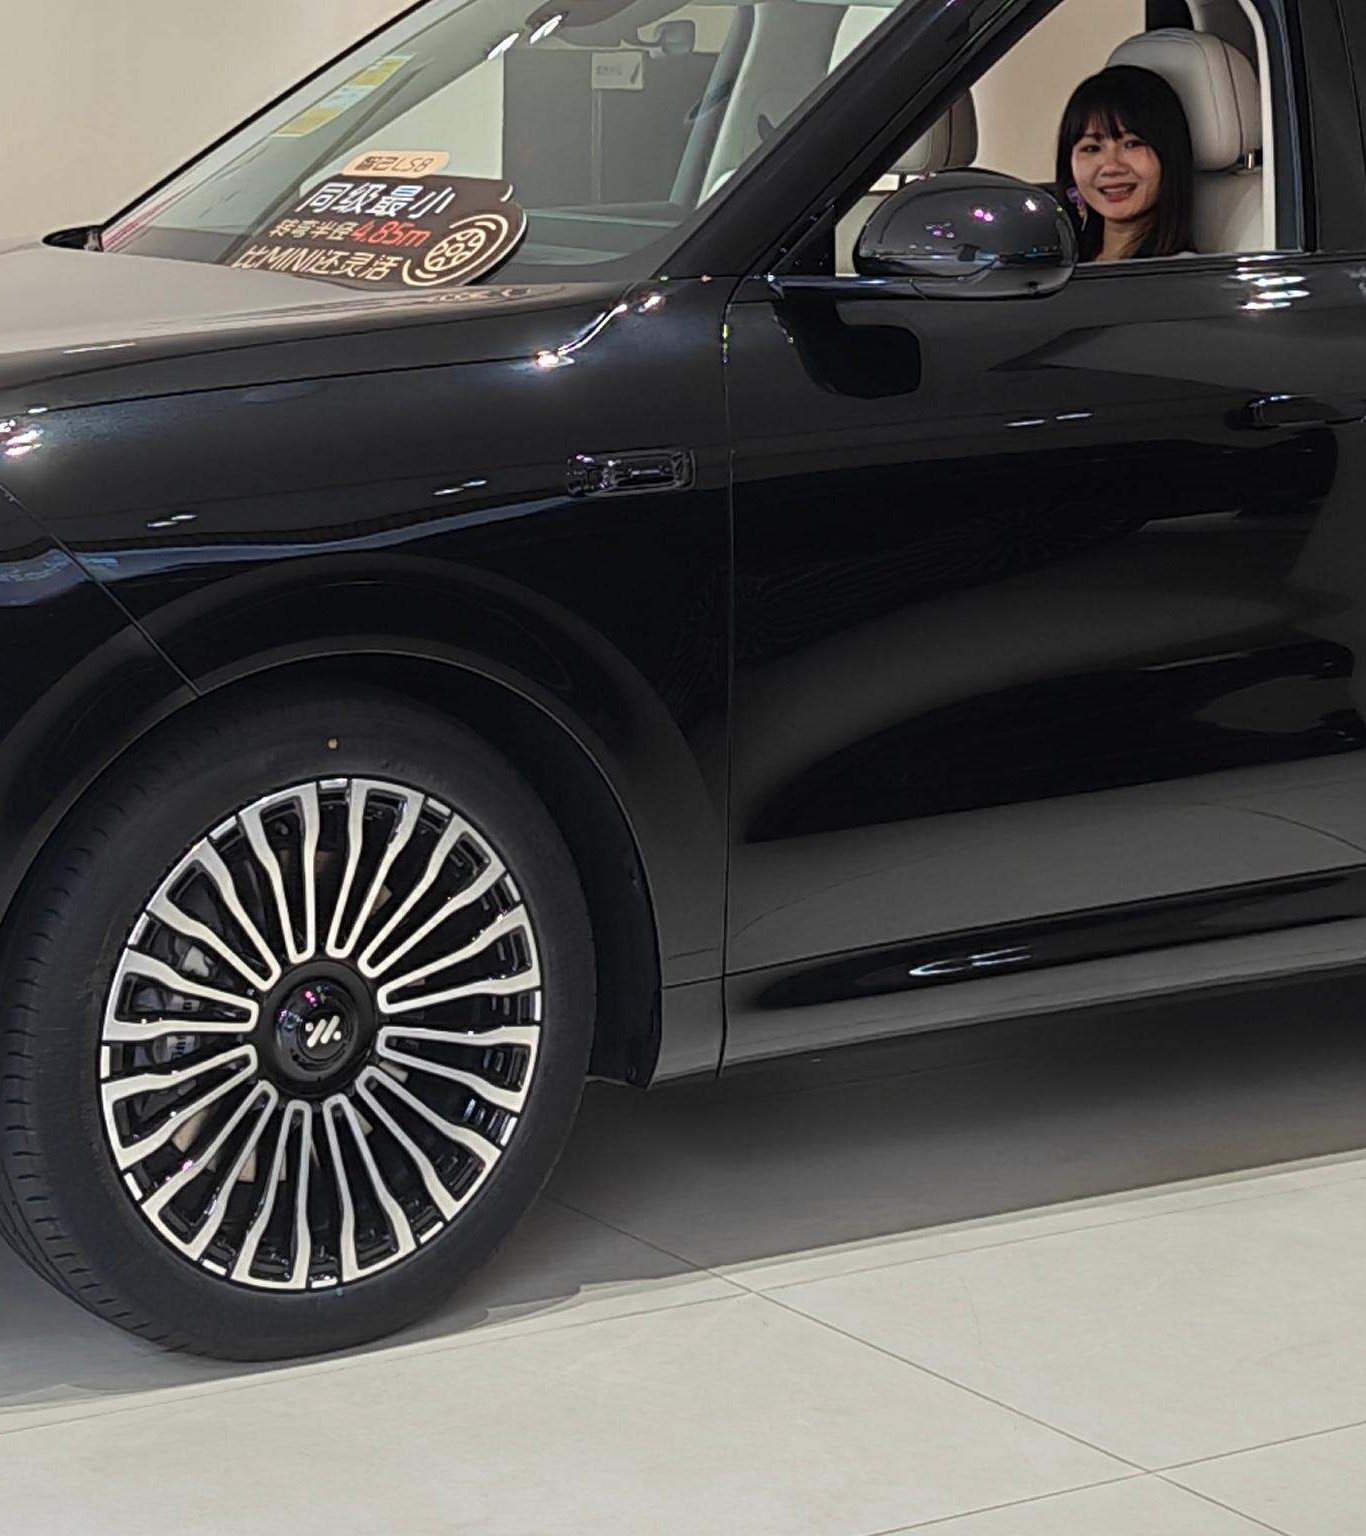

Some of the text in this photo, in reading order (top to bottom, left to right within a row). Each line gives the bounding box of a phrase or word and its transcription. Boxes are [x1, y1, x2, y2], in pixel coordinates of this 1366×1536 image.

[295, 182, 456, 219] 同级最小
[269, 218, 433, 248] 转弯半径4.85m
[231, 245, 403, 281] 比MINI还灵活
